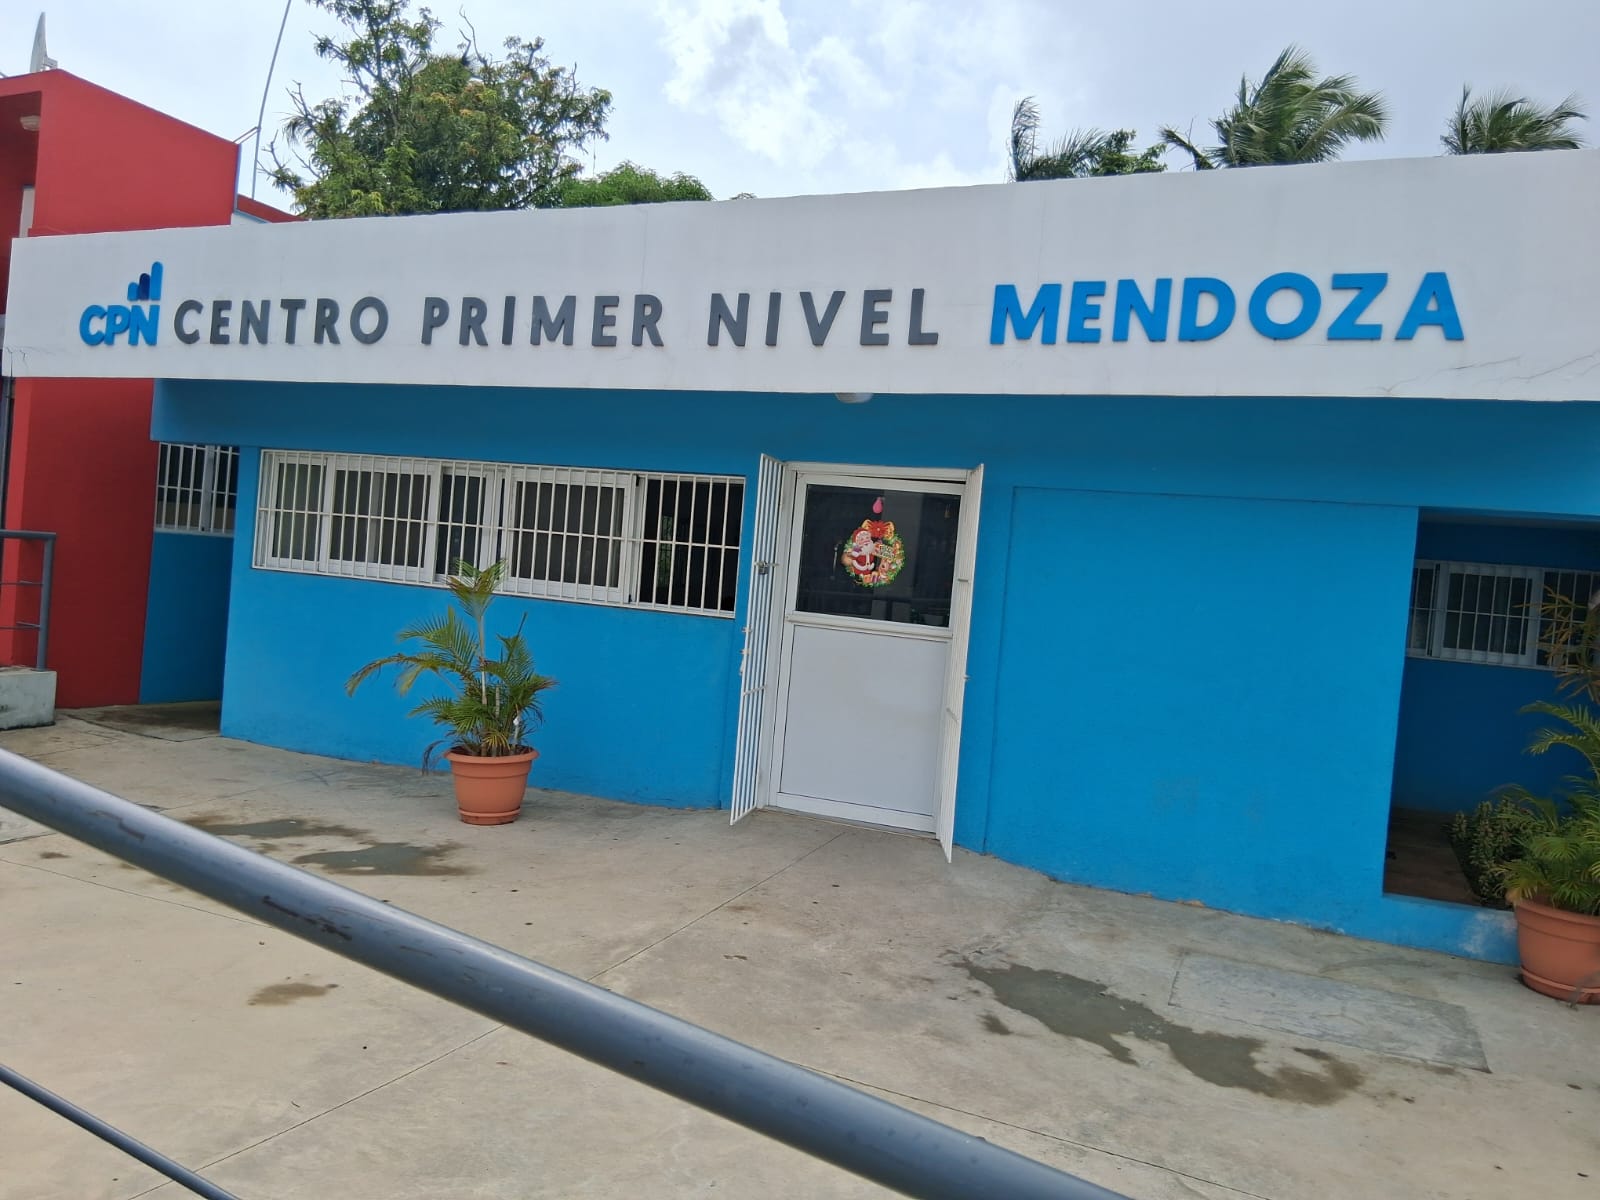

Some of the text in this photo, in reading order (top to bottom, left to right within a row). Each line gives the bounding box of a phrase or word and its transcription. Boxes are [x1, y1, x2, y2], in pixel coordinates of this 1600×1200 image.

[79, 272, 1464, 347] CPN CENTRO PRIMER NIVEL MENDOZA
